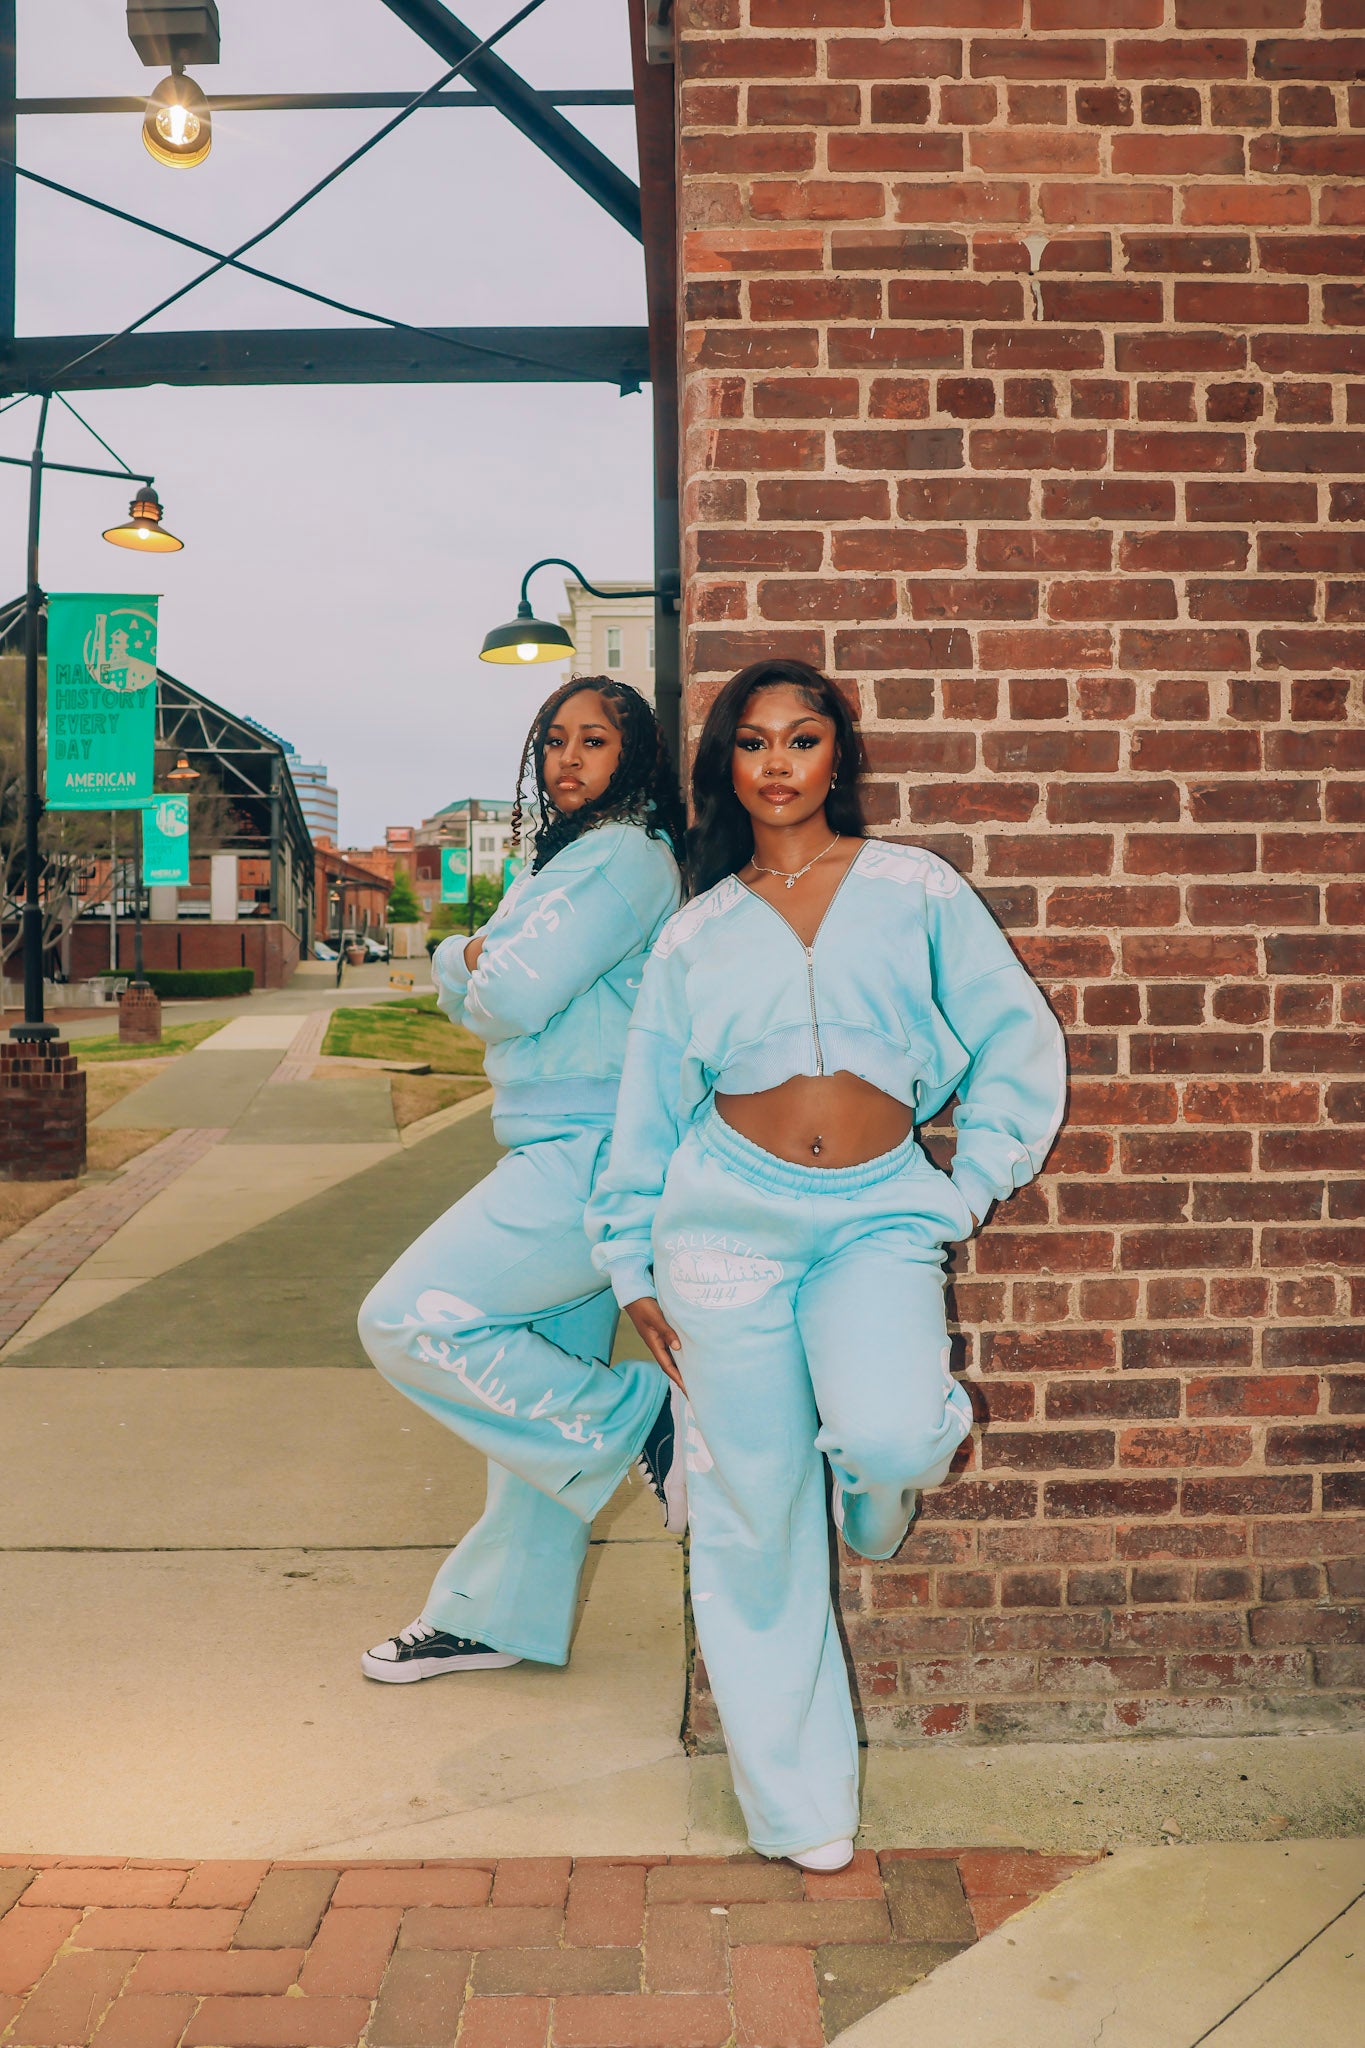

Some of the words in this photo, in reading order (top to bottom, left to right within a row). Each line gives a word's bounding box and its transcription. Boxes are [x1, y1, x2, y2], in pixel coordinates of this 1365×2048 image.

[55, 664, 111, 685] MAKE
[55, 689, 150, 710] HISTORY
[55, 713, 120, 735] EVERY
[55, 739, 93, 760] DAY
[65, 771, 137, 787] AMERICAN
